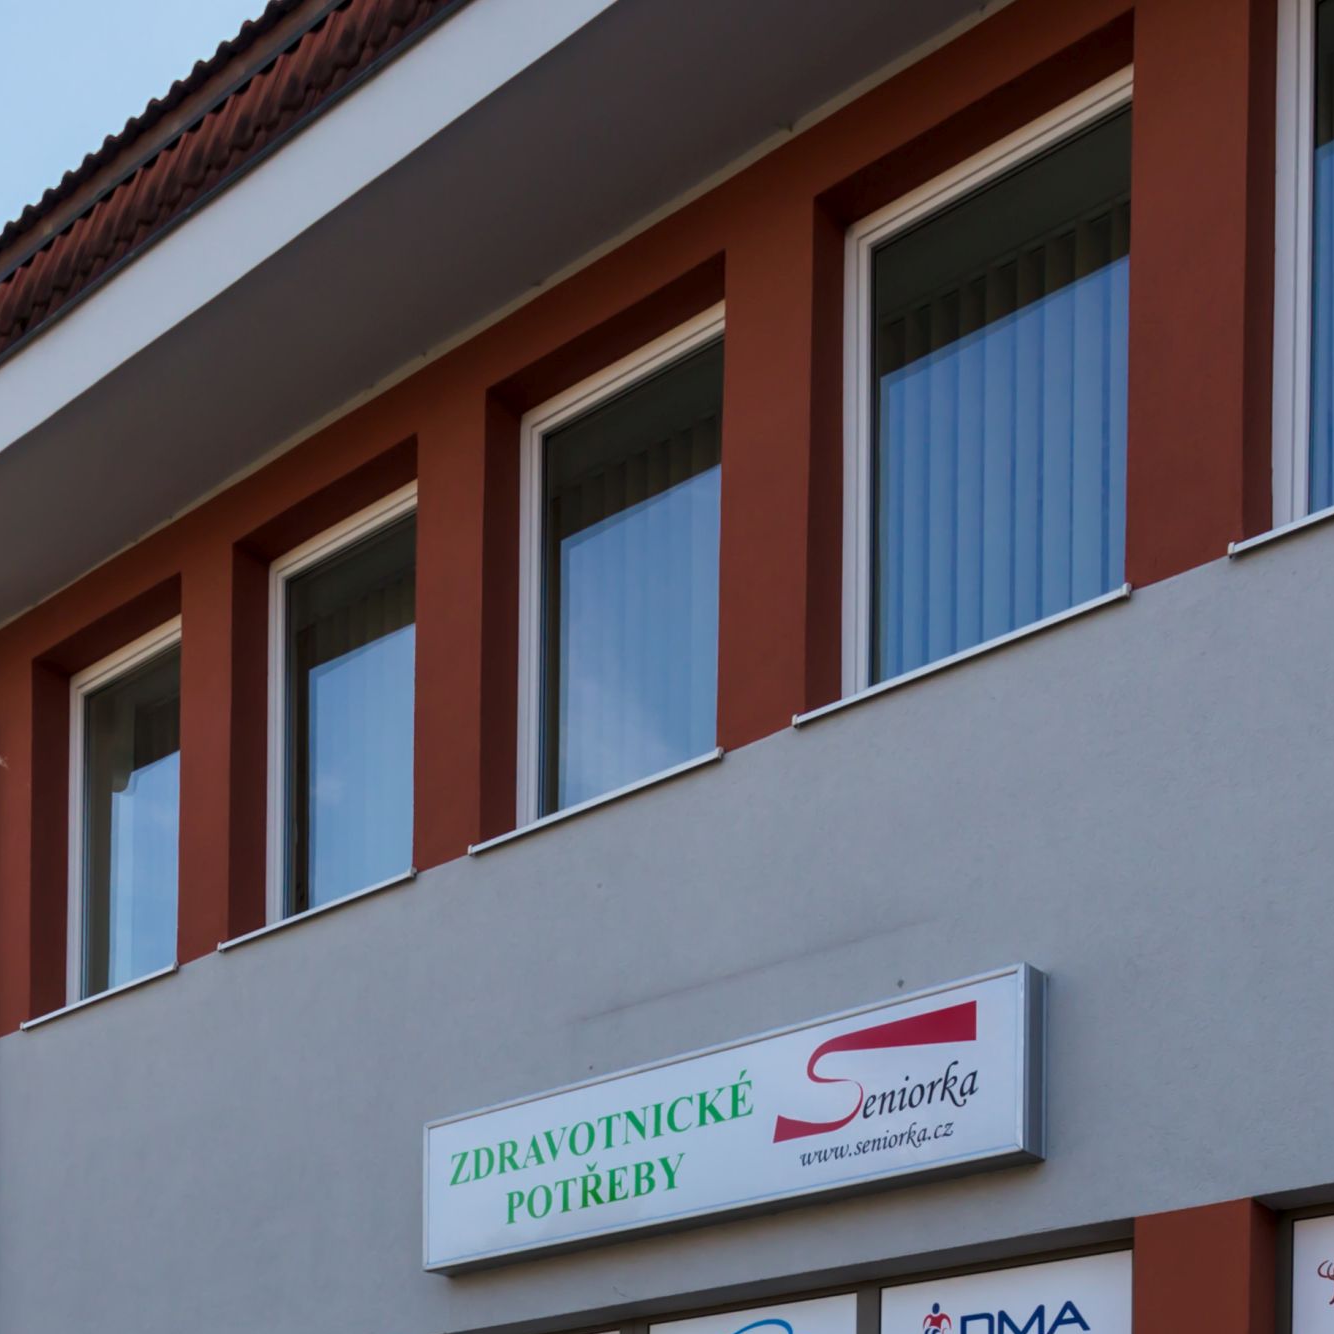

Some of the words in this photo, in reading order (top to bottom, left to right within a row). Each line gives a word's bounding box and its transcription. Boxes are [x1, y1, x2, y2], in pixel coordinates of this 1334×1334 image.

[773, 1000, 977, 1144] Seniorka
[449, 1070, 754, 1187] ZDRAVOTNICKÉ
[800, 1118, 954, 1168] www.seniorka.cz
[505, 1153, 686, 1225] POTŘEBY
